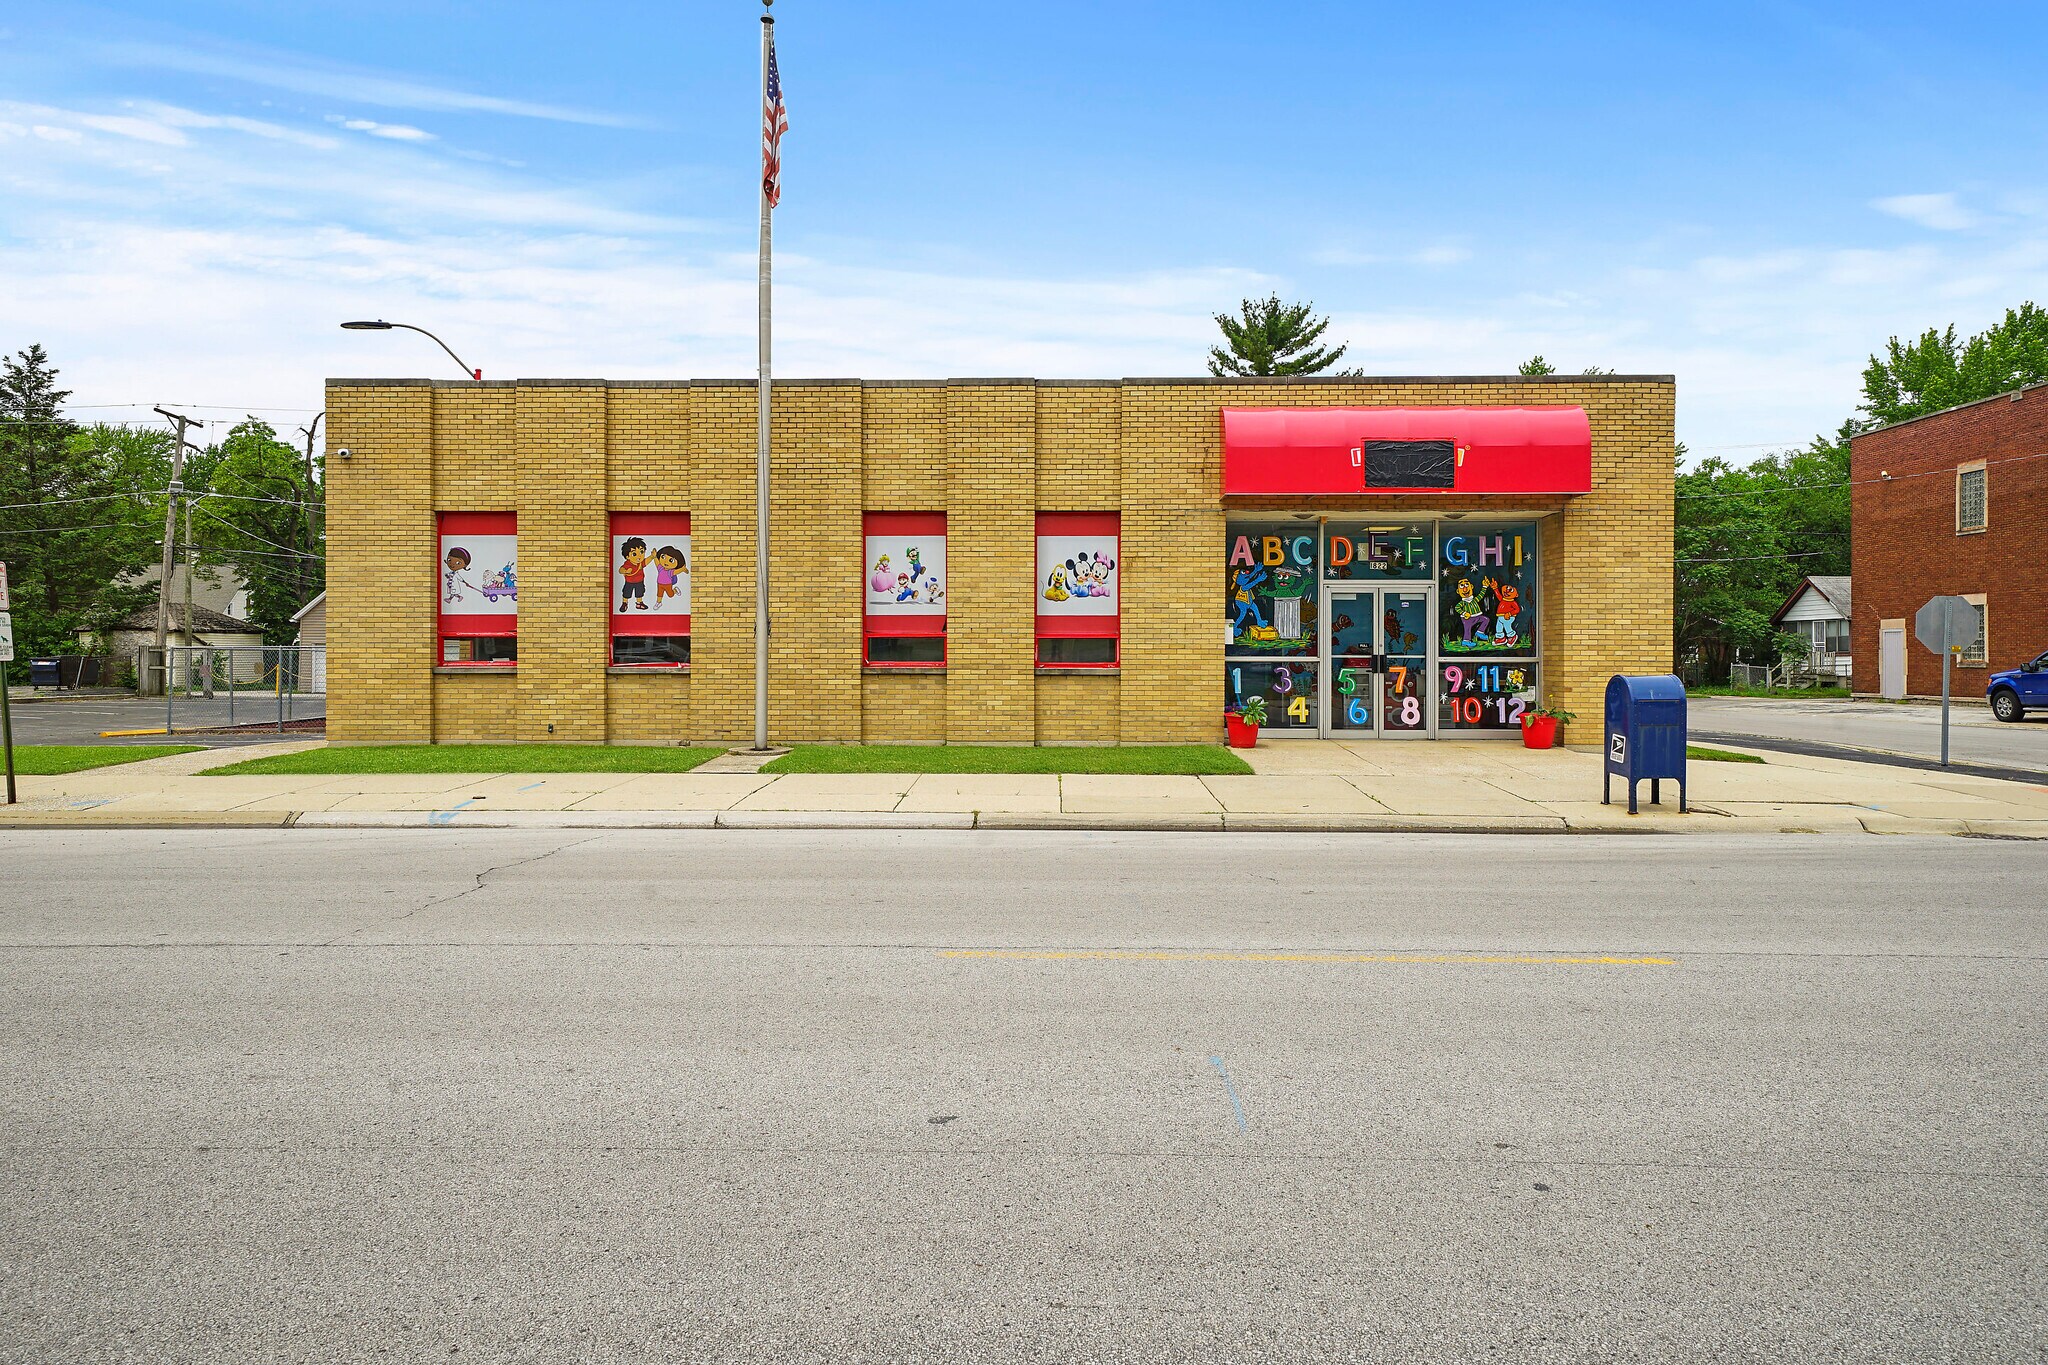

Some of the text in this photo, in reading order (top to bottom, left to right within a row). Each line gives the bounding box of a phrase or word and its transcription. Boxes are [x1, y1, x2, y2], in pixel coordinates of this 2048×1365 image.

[1370, 562, 1387, 570] 1822
[1232, 667, 1292, 694] 1 3
[1337, 668, 1356, 695] 5
[1388, 666, 1407, 693] 7
[1444, 665, 1501, 693] 9 11
[1287, 696, 1309, 723] 4
[1347, 697, 1369, 725] 6
[1400, 696, 1421, 725] 8
[1450, 697, 1526, 724] 10 12
